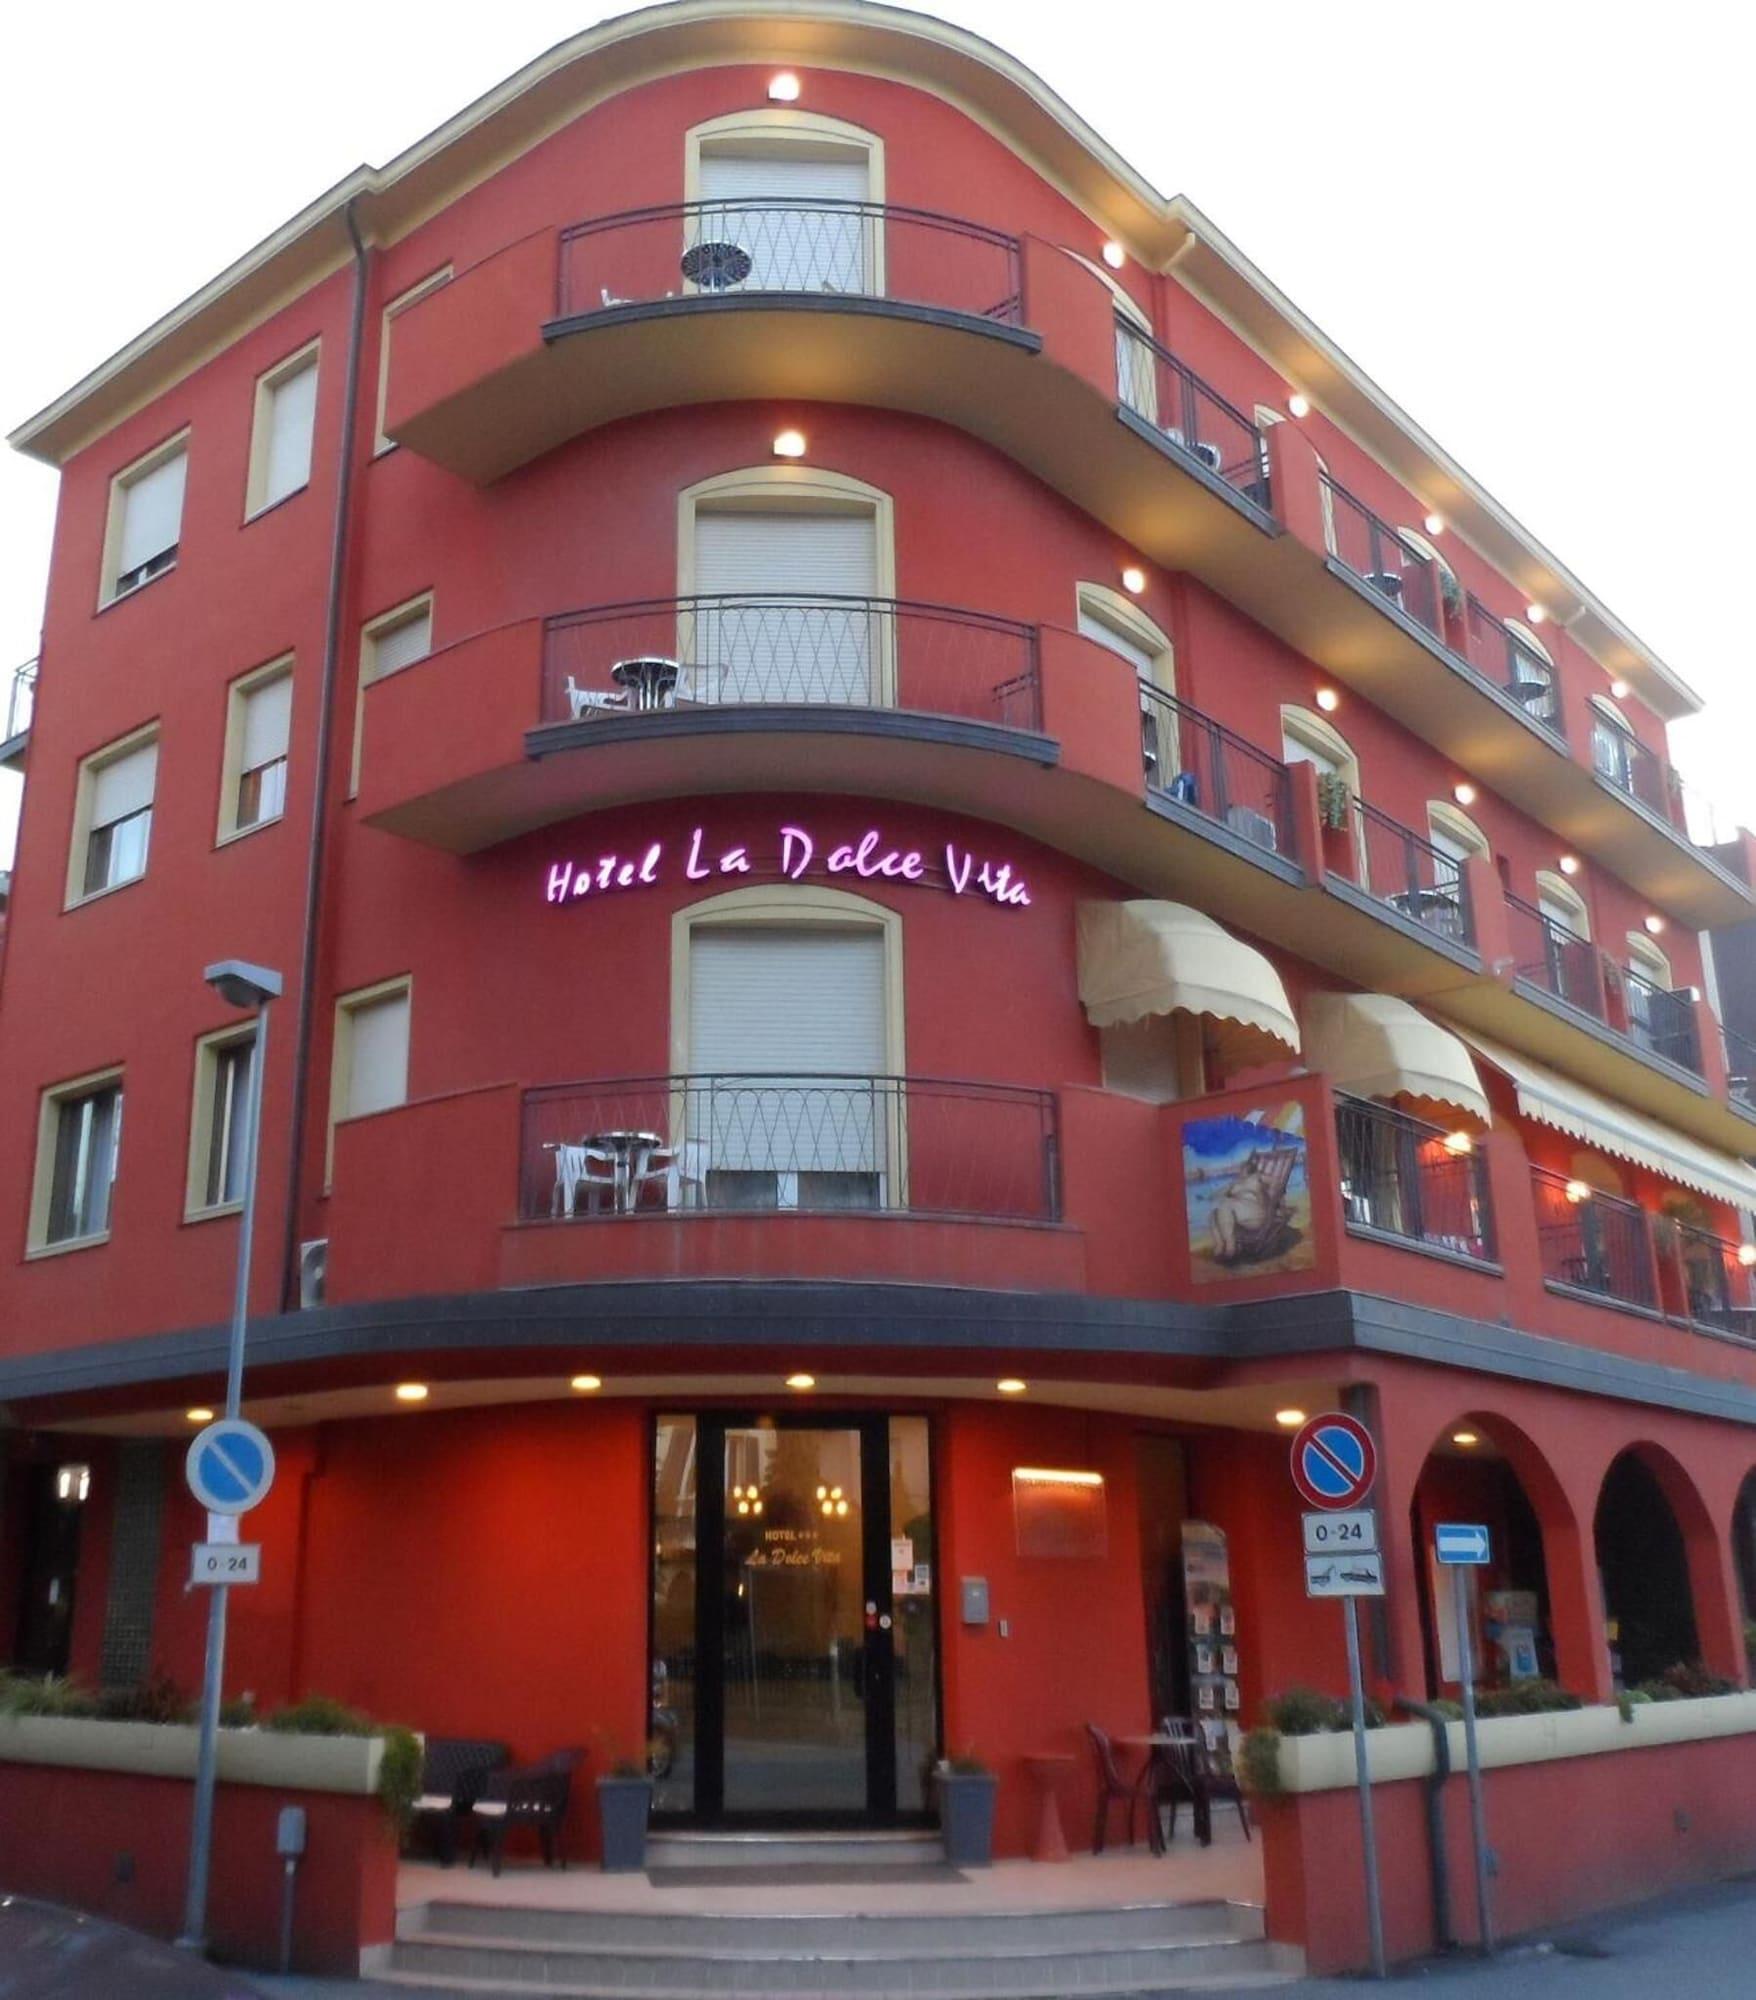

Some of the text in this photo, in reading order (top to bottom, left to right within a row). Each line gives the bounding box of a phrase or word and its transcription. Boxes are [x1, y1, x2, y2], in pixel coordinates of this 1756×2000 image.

[546, 826, 1032, 905] Hotel La Dolce Vita
[765, 1530, 797, 1541] HOTEL
